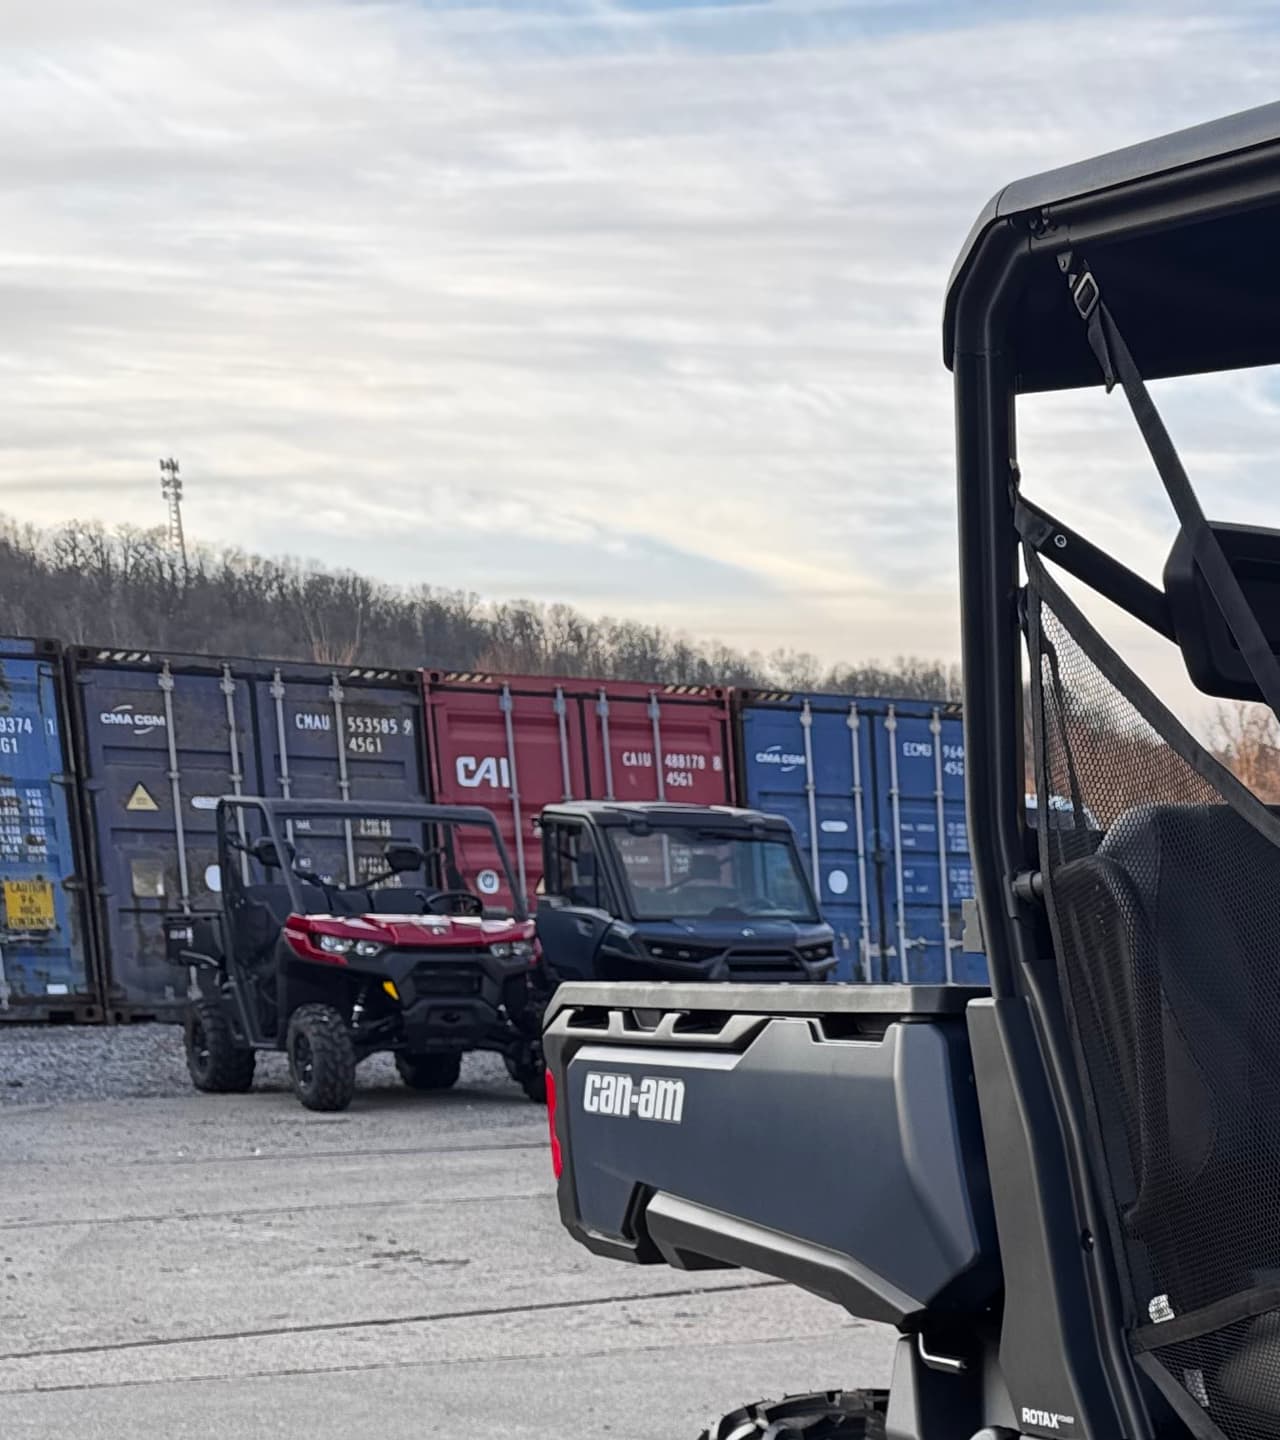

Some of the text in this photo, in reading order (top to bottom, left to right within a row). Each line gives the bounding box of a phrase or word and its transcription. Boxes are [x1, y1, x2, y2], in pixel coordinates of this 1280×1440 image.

[101, 712, 166, 727] CMA CGM
[296, 713, 413, 735] CMAU 553585 9
[349, 737, 382, 753] 45G1
[622, 751, 652, 767] CAIU
[456, 755, 511, 789] CAI
[584, 1073, 685, 1122] can-am
[1022, 1407, 1060, 1430] ROTAX
